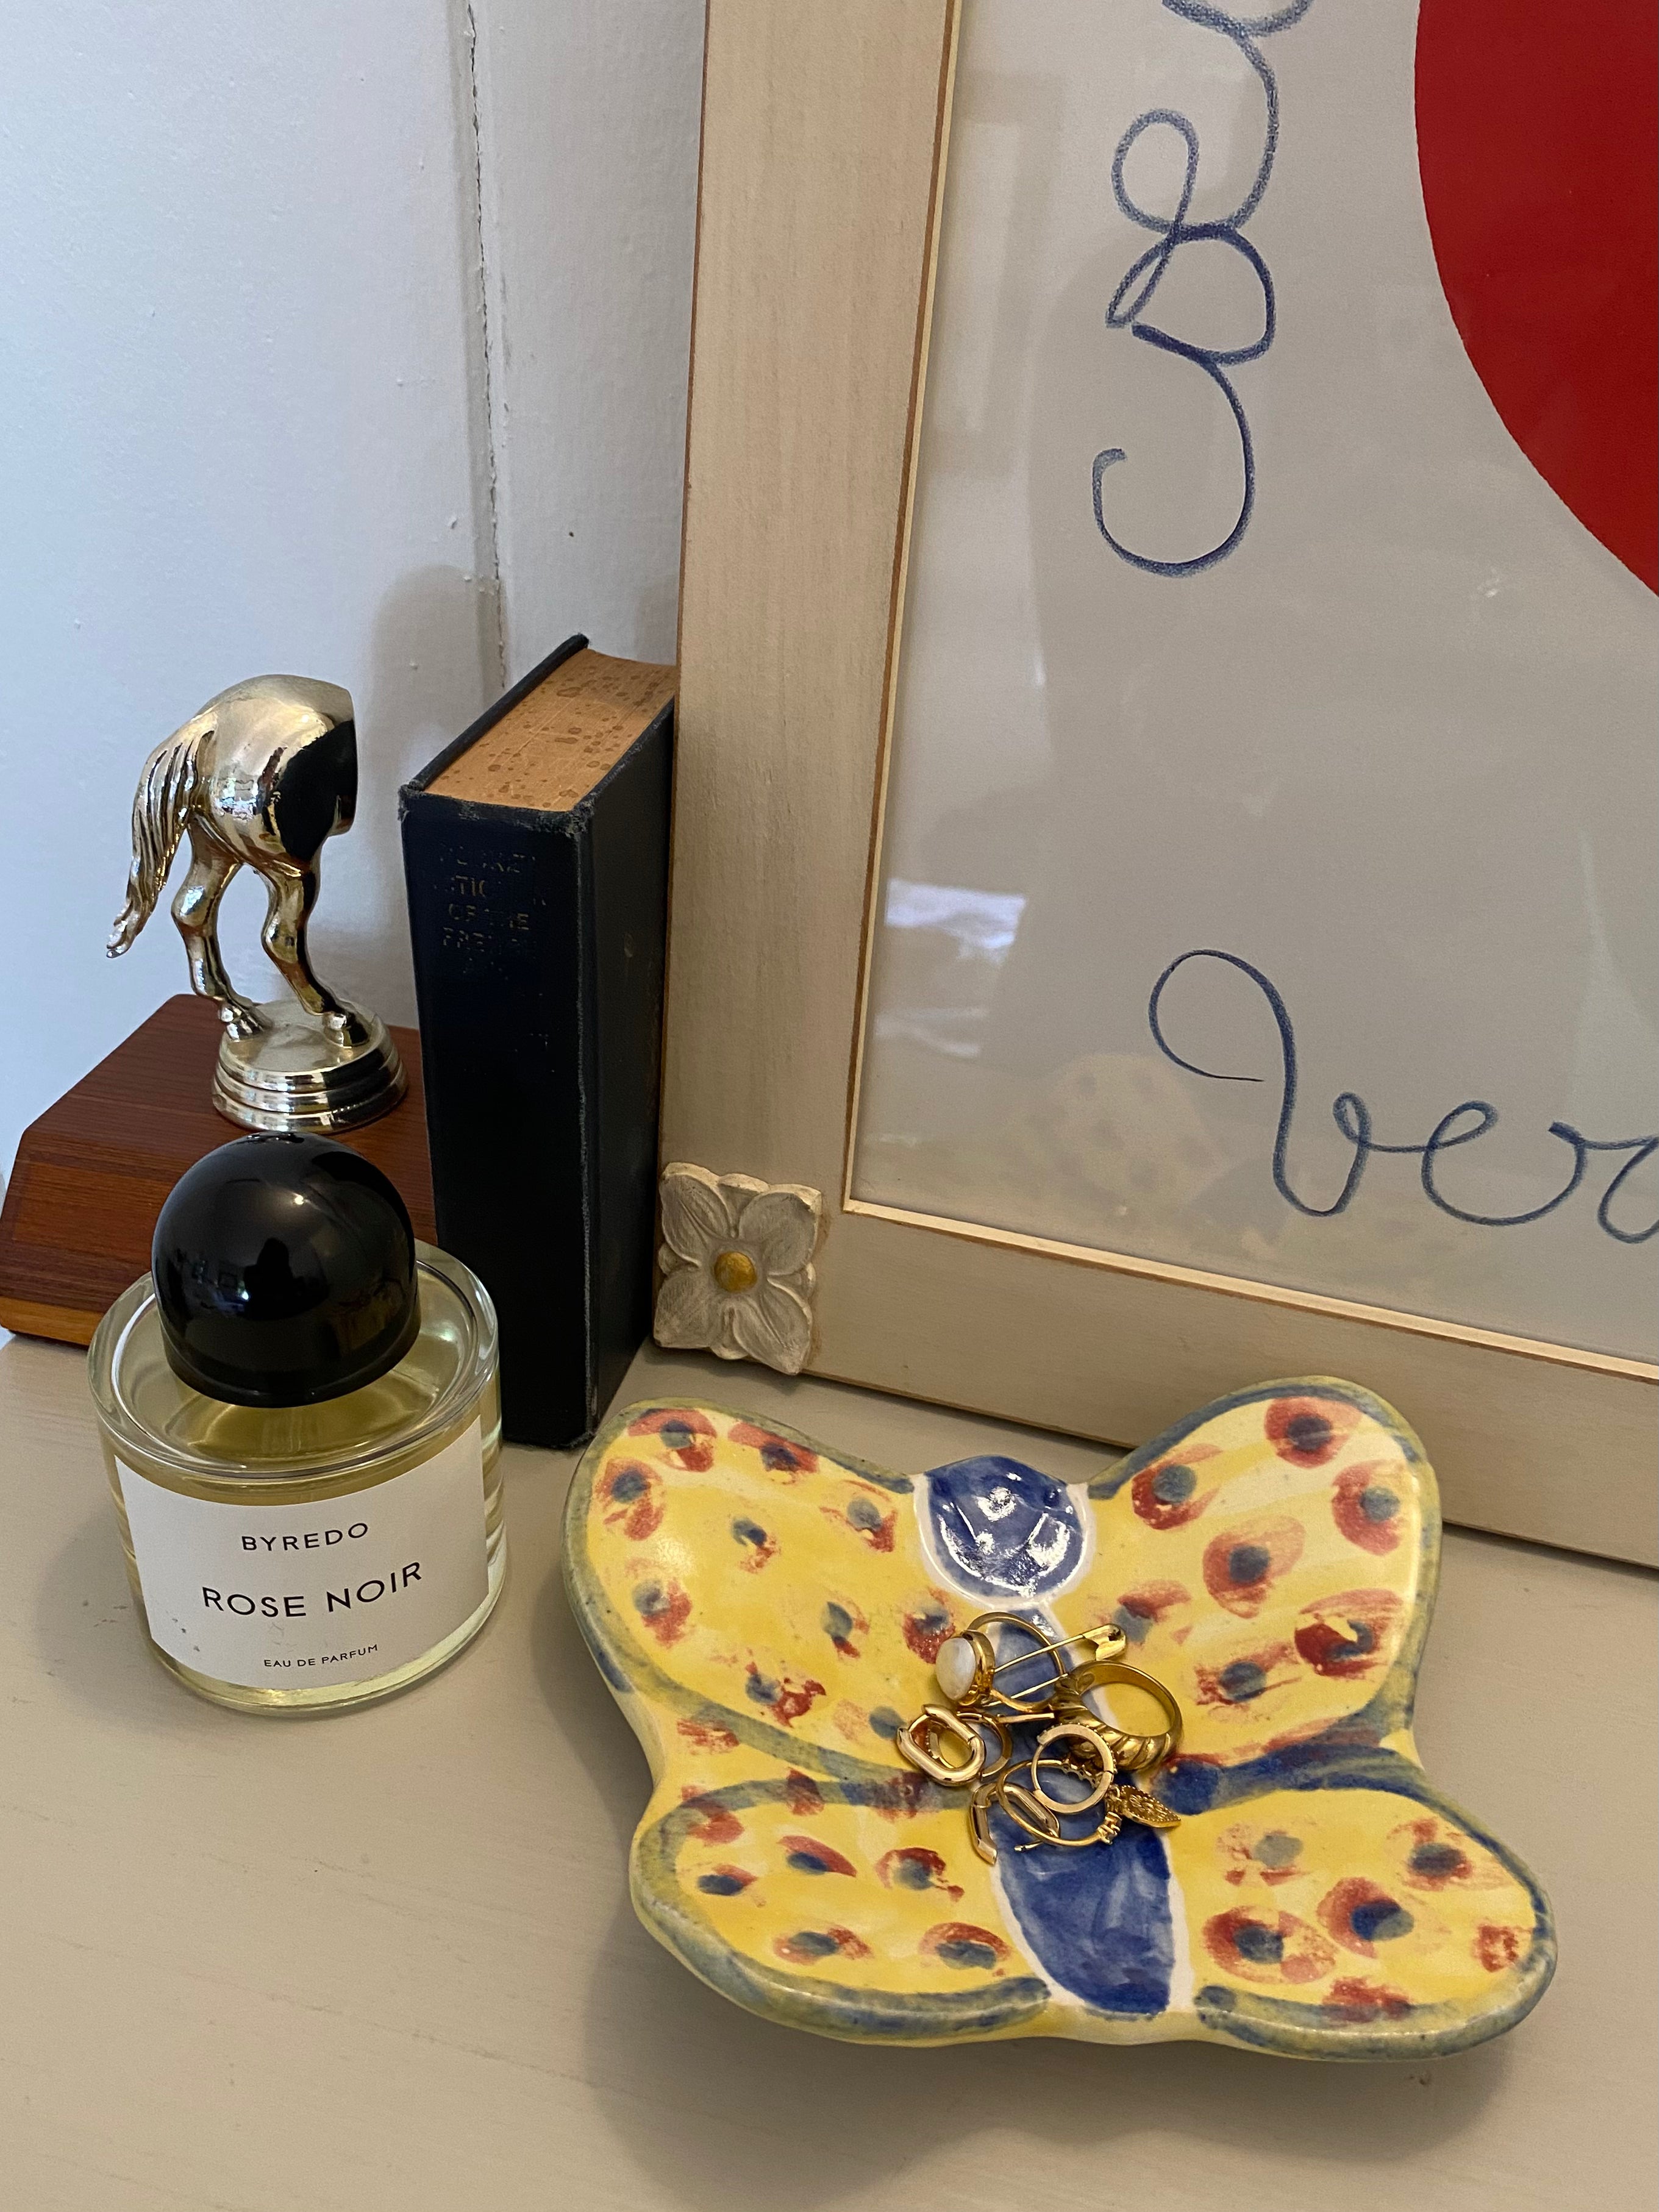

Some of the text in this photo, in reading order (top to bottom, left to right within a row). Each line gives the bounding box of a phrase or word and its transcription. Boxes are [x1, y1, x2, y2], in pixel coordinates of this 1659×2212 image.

[241, 1522, 368, 1552] BYREDO
[202, 1561, 422, 1618] ROSE NOIR
[263, 1644, 378, 1668] EAU DE PARFUM
